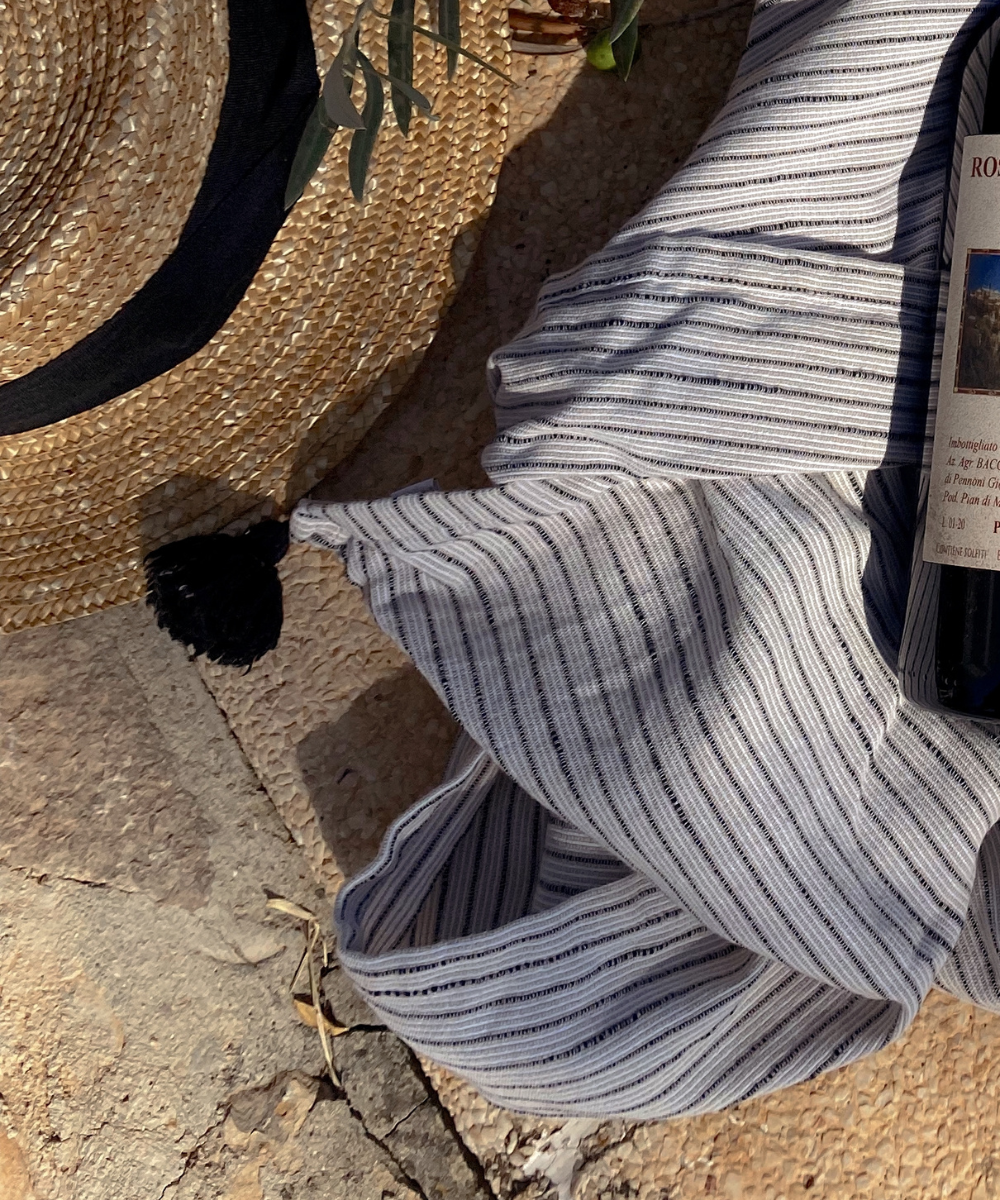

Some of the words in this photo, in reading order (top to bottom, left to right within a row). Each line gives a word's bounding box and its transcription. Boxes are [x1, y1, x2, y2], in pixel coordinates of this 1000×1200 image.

[948, 436, 998, 454] Imbottigliato
[944, 473, 952, 485] di
[953, 473, 986, 488] Pennoni
[960, 492, 980, 506] Pian
[981, 494, 992, 507] di
